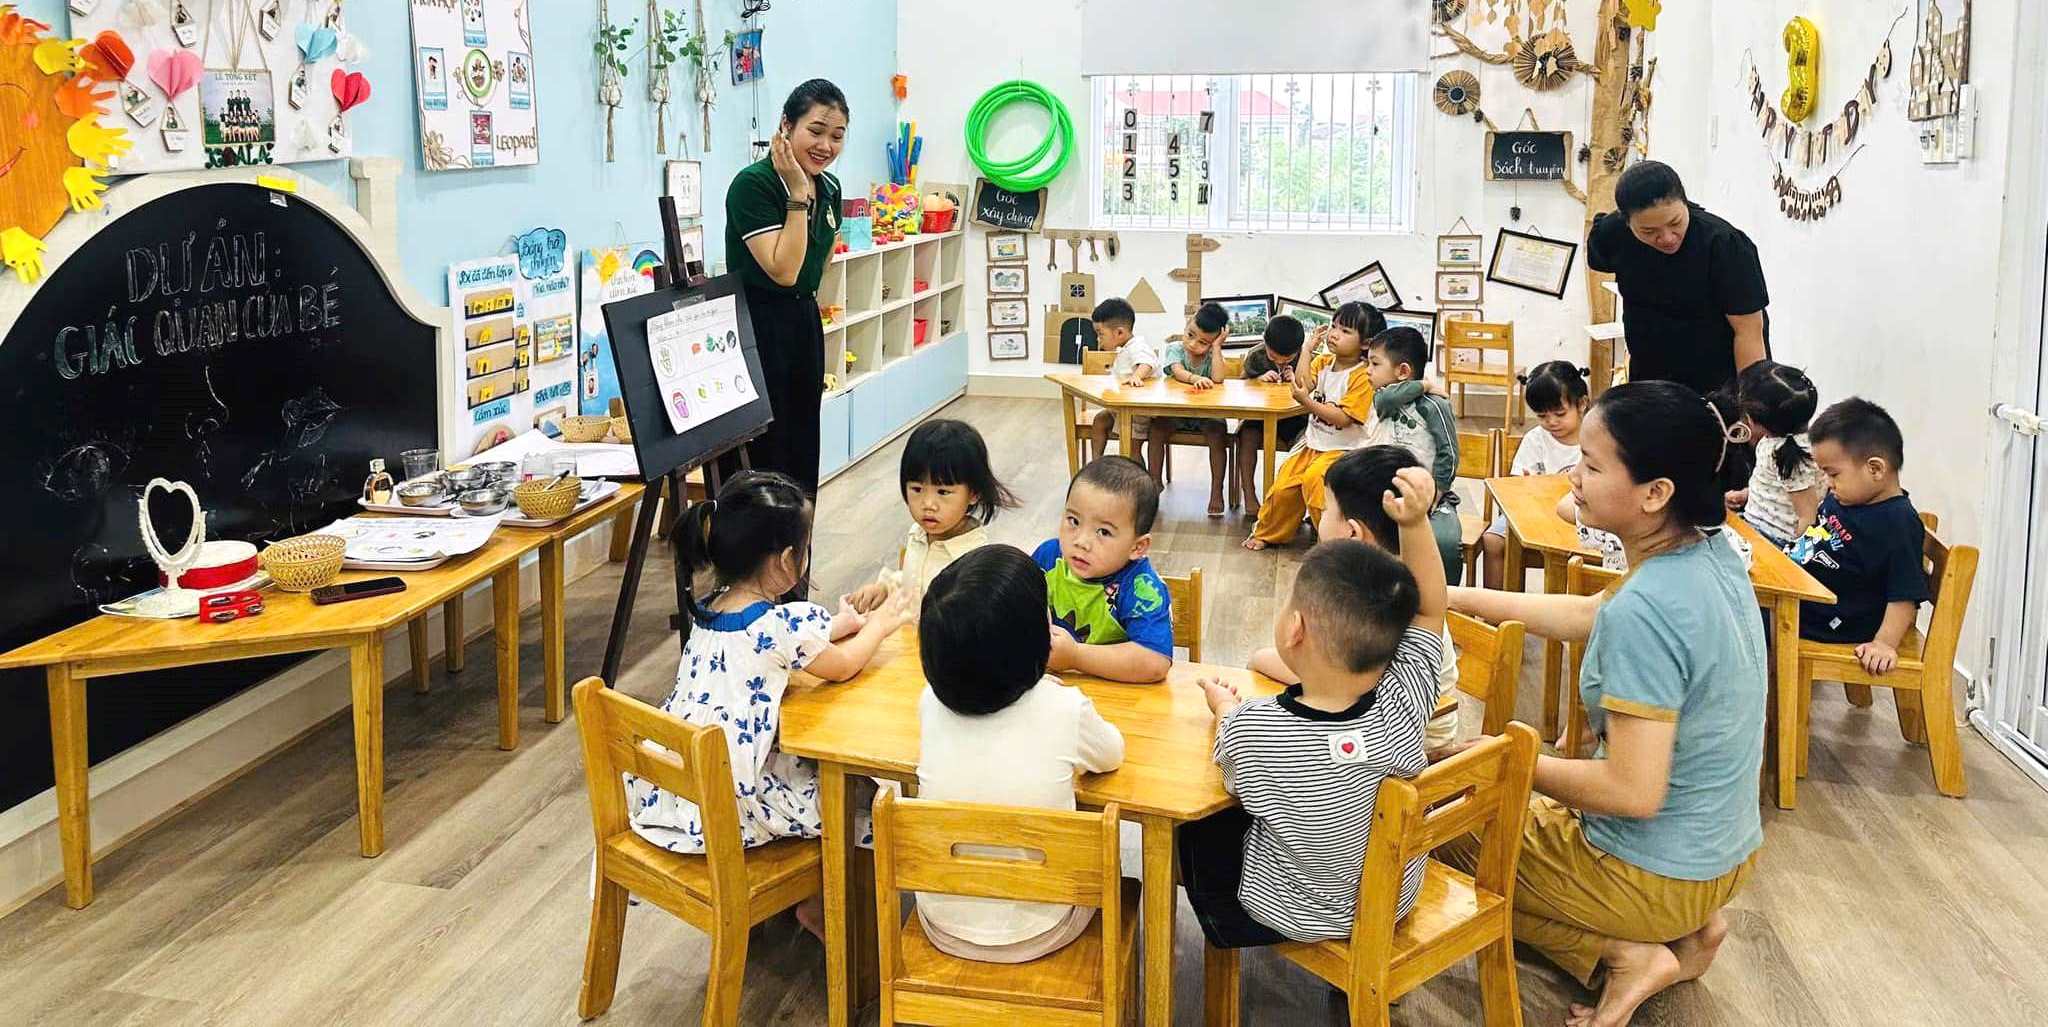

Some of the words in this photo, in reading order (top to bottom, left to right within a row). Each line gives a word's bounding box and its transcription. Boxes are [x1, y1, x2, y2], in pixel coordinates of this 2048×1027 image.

[1169, 133, 1181, 154] 4
[1124, 157, 1136, 178] 2
[1169, 157, 1181, 179] 5
[1122, 182, 1134, 202] 3
